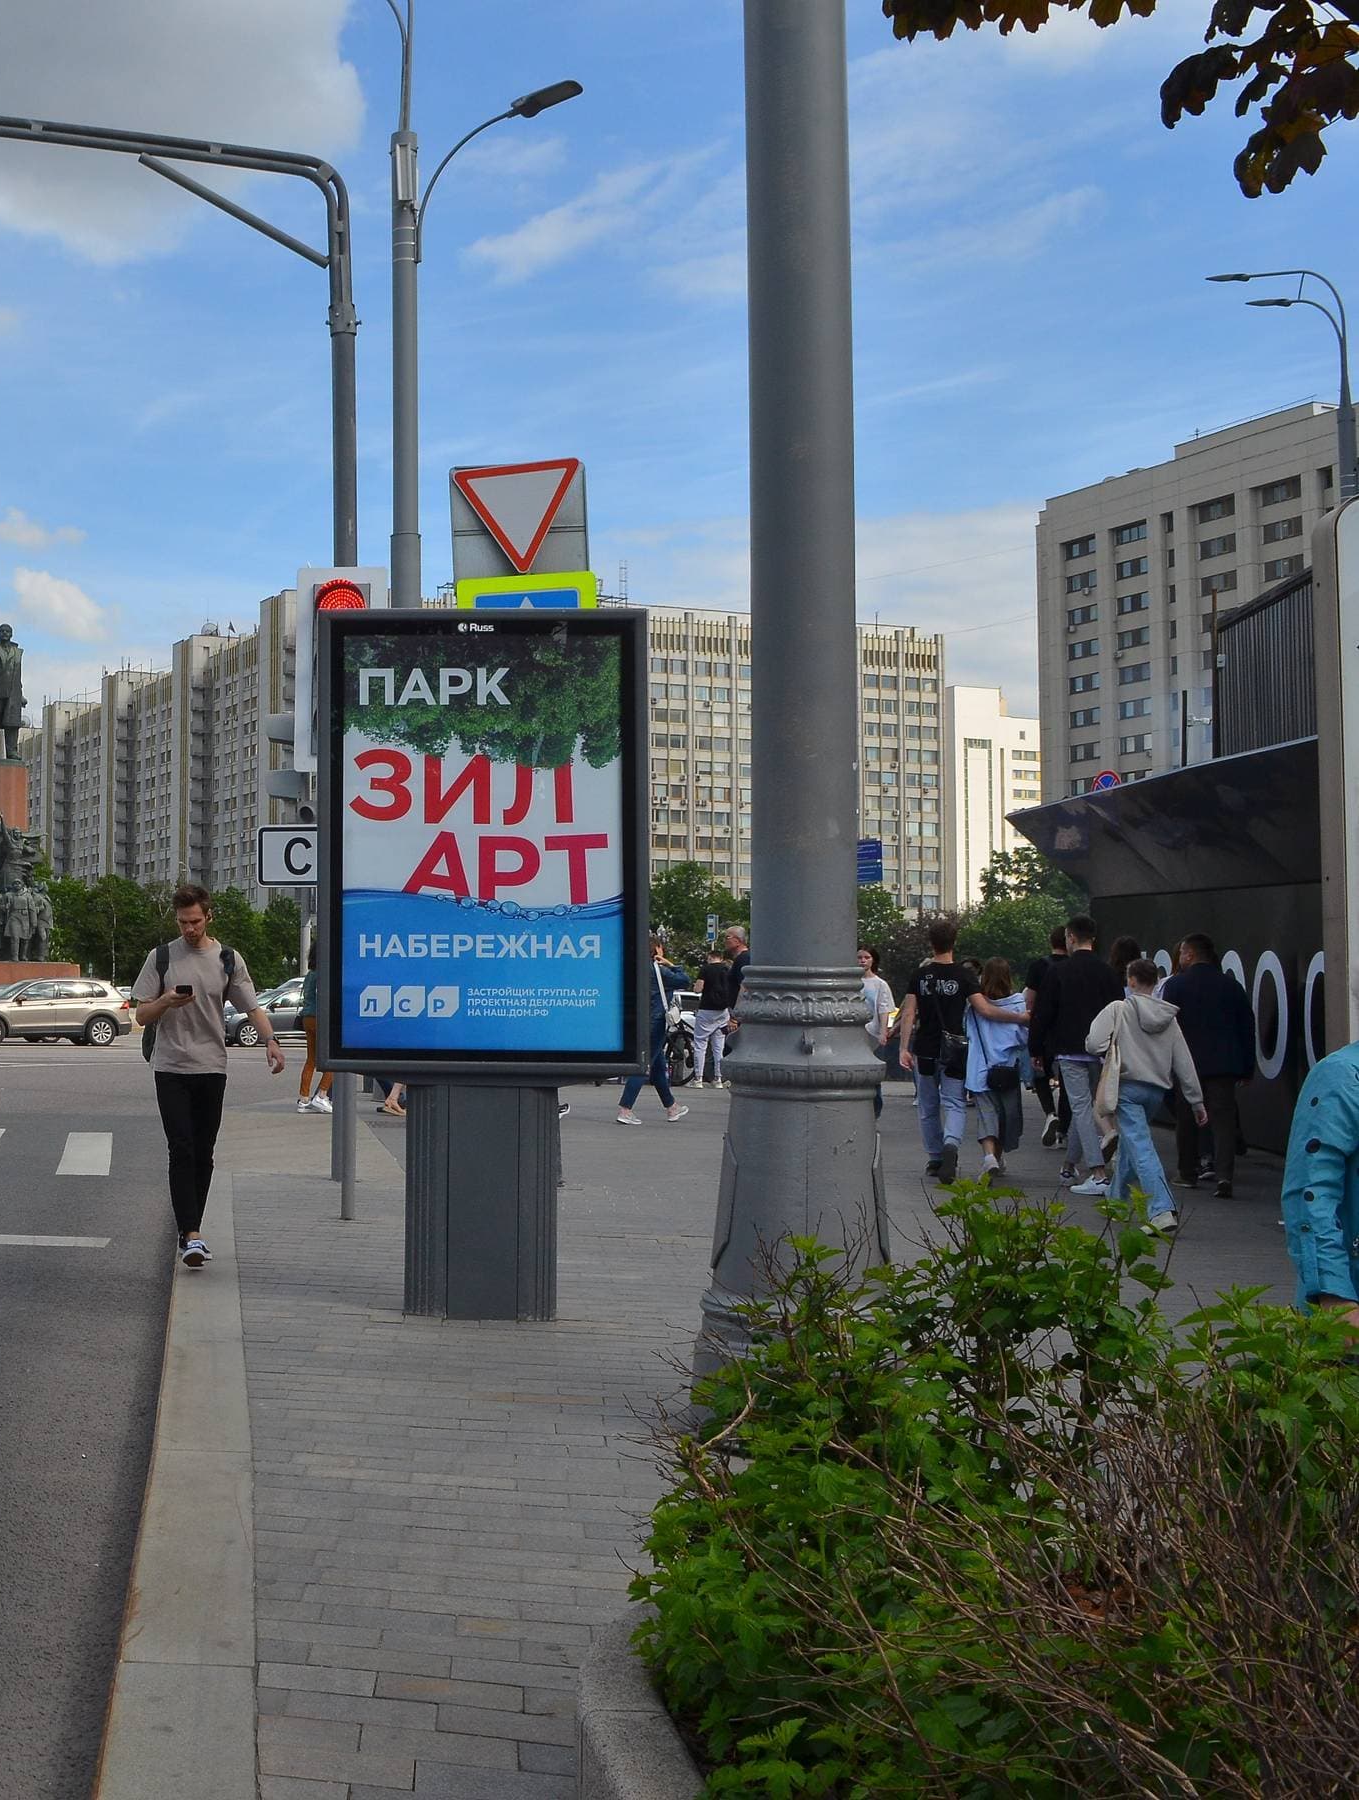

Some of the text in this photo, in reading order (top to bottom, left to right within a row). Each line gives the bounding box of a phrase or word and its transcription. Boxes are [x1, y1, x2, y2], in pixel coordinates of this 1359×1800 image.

[469, 623, 495, 633] Russ
[358, 667, 511, 706] ПАРК
[349, 748, 574, 826] ЗИЛ
[401, 830, 609, 906] АРТ
[358, 934, 601, 959] НАБЕРЕЖНАЯ
[467, 987, 535, 997] ЗАСТРОЙЩИК
[538, 989, 577, 997] ГРУППА
[467, 998, 596, 1008] ПРОЕКТНАЯ ДЕКЛАРАЦИЯ
[467, 1008, 549, 1018] НА НАШ.ДОМ.РФ
